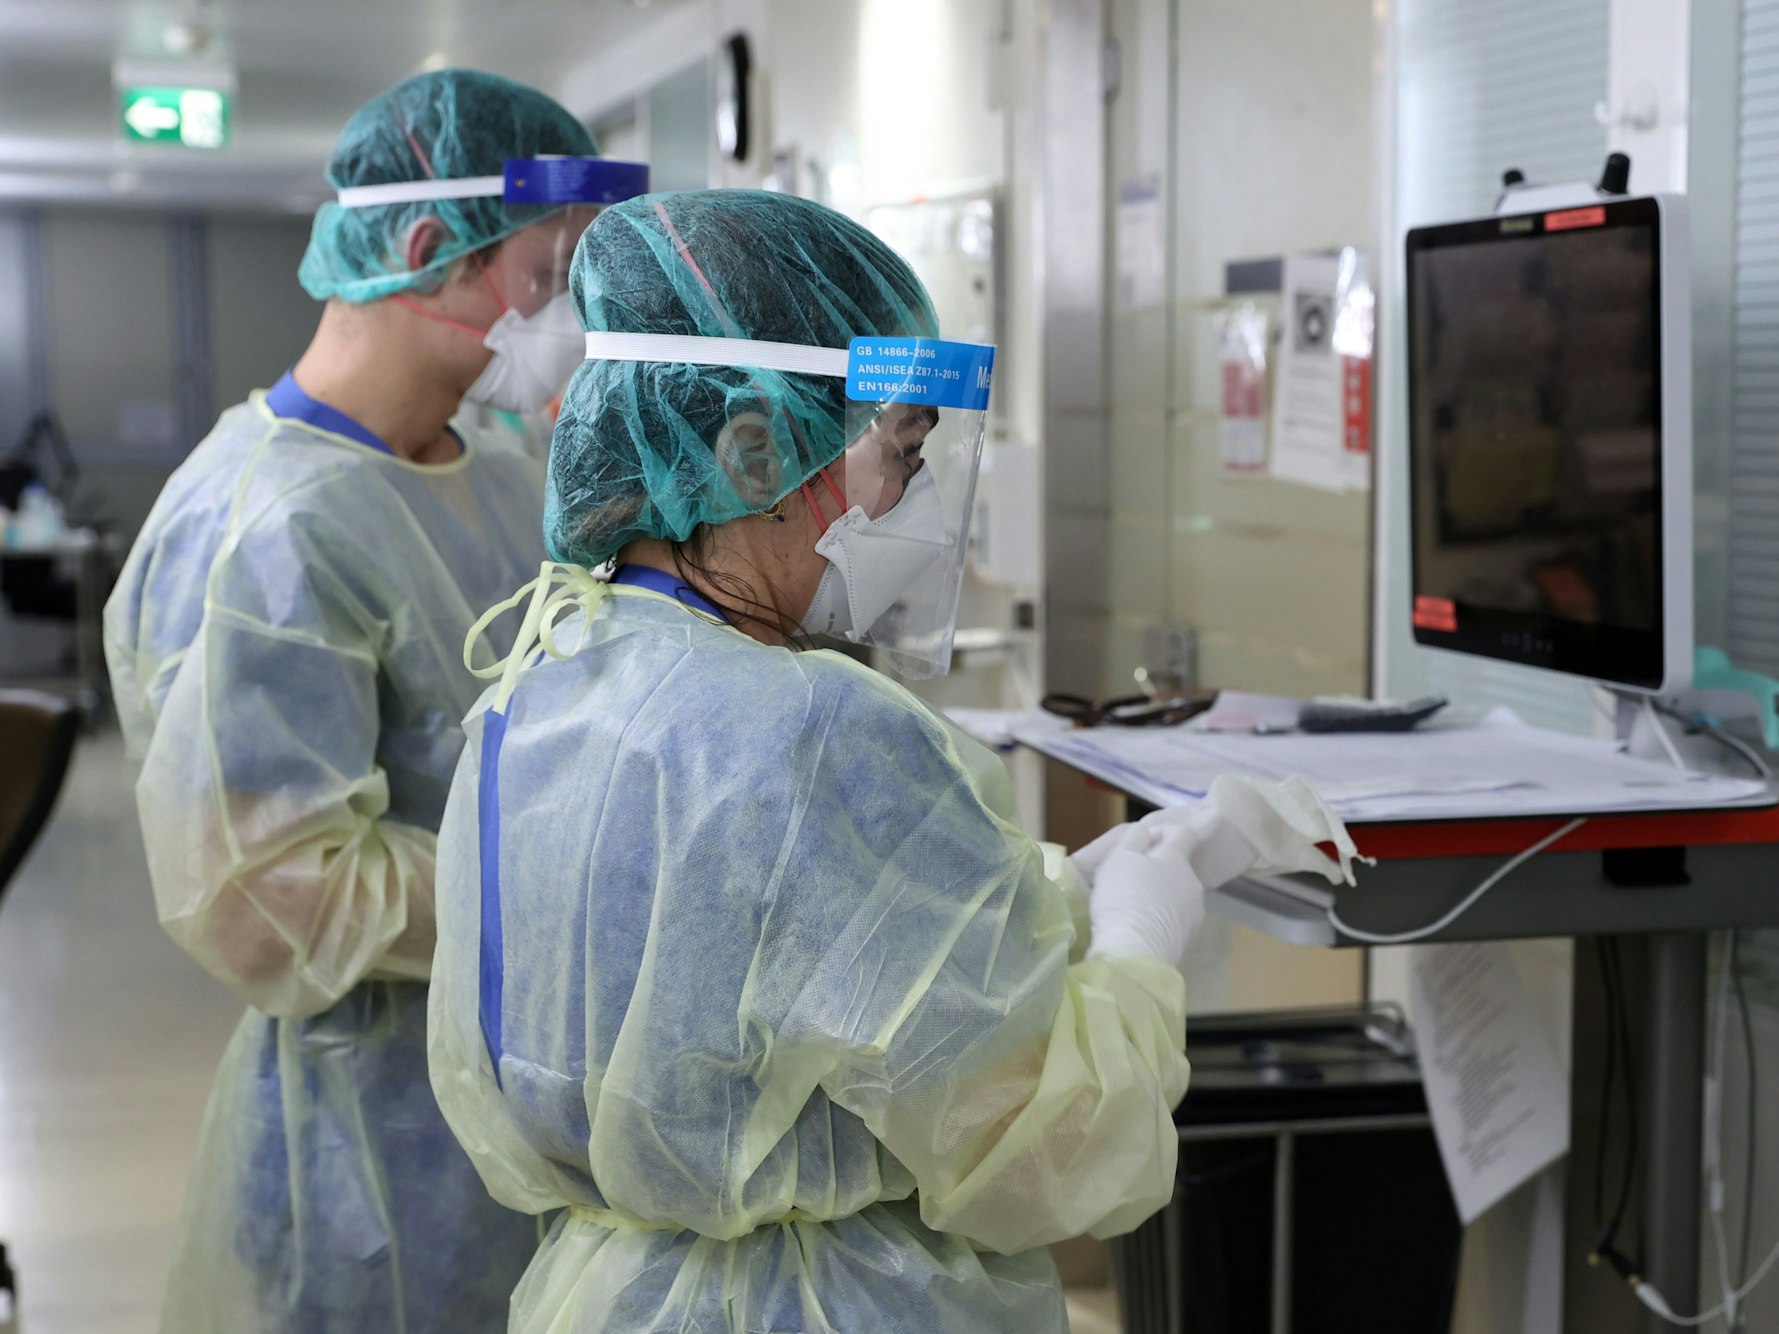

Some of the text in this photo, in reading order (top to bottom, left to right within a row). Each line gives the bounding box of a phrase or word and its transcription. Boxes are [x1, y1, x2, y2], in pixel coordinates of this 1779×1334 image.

[856, 345, 936, 359] GB 14866-2006
[857, 364, 961, 380] ANSI/ISEA Z87.1-2015
[858, 381, 927, 395] EN166:2001
